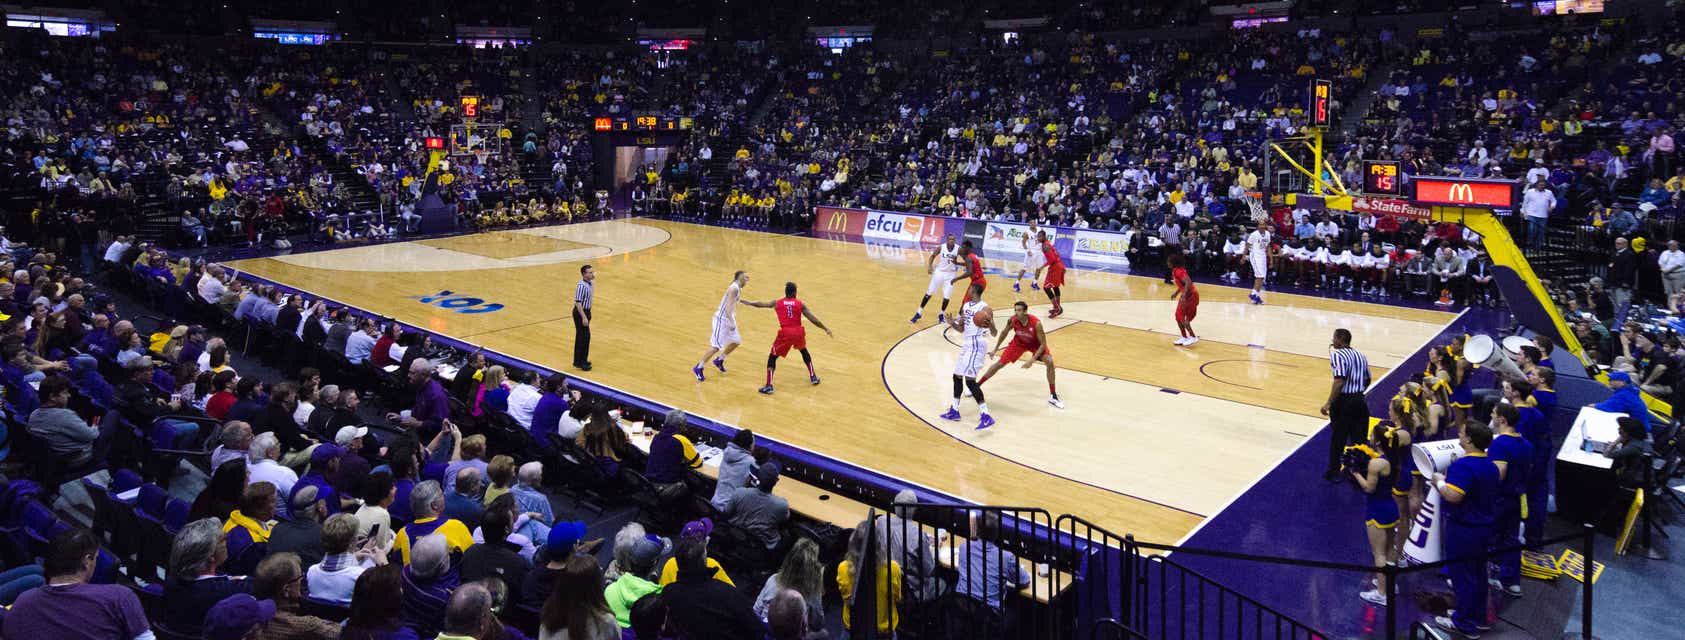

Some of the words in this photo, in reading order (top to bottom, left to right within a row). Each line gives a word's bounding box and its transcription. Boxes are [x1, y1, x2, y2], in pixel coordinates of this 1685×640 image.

[637, 116, 657, 126] 19:38
[637, 137, 656, 145] LSU
[1371, 164, 1397, 177] 19:38
[1378, 177, 1392, 190] 15
[866, 214, 903, 233] efcu
